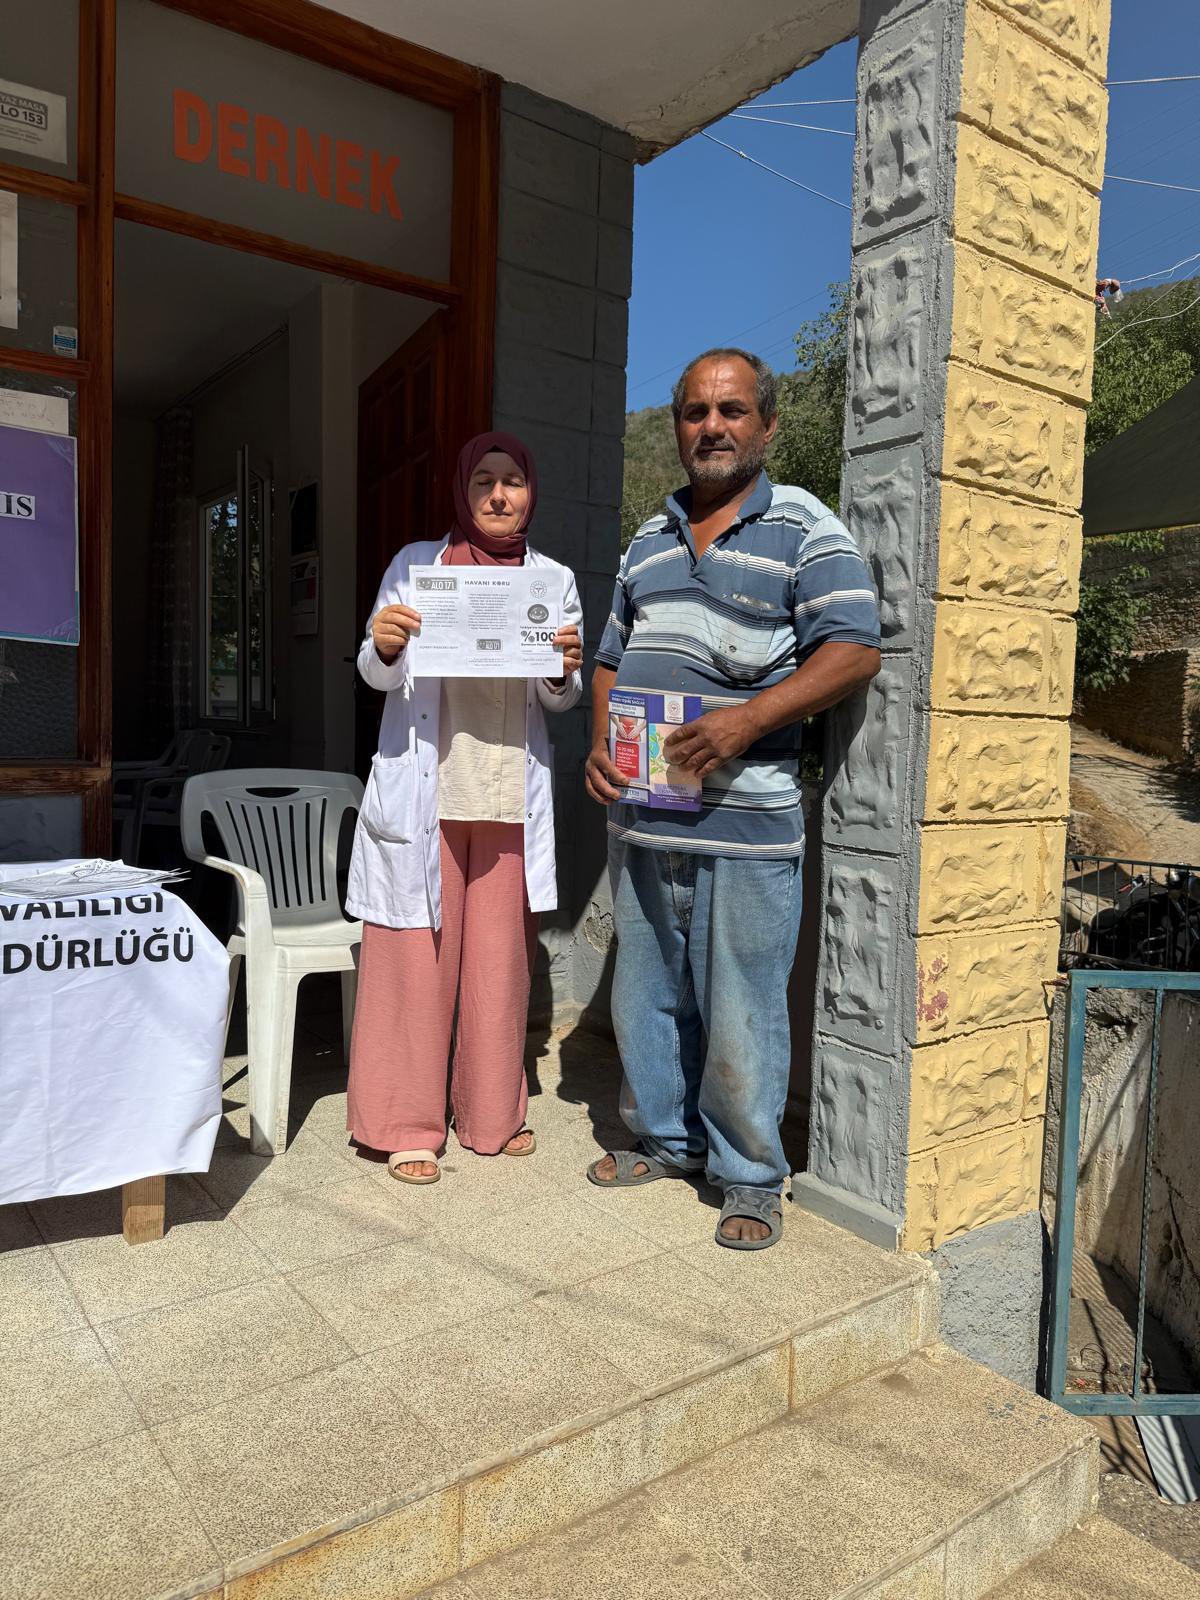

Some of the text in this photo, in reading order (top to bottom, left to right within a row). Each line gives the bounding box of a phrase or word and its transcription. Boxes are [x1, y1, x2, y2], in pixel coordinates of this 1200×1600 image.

[0, 104, 43, 125] LO 153
[173, 87, 404, 222] DERNEK
[0, 494, 33, 518] IS
[431, 581, 444, 590] ALO
[3, 926, 194, 975] DÜRLÜĞÜ
